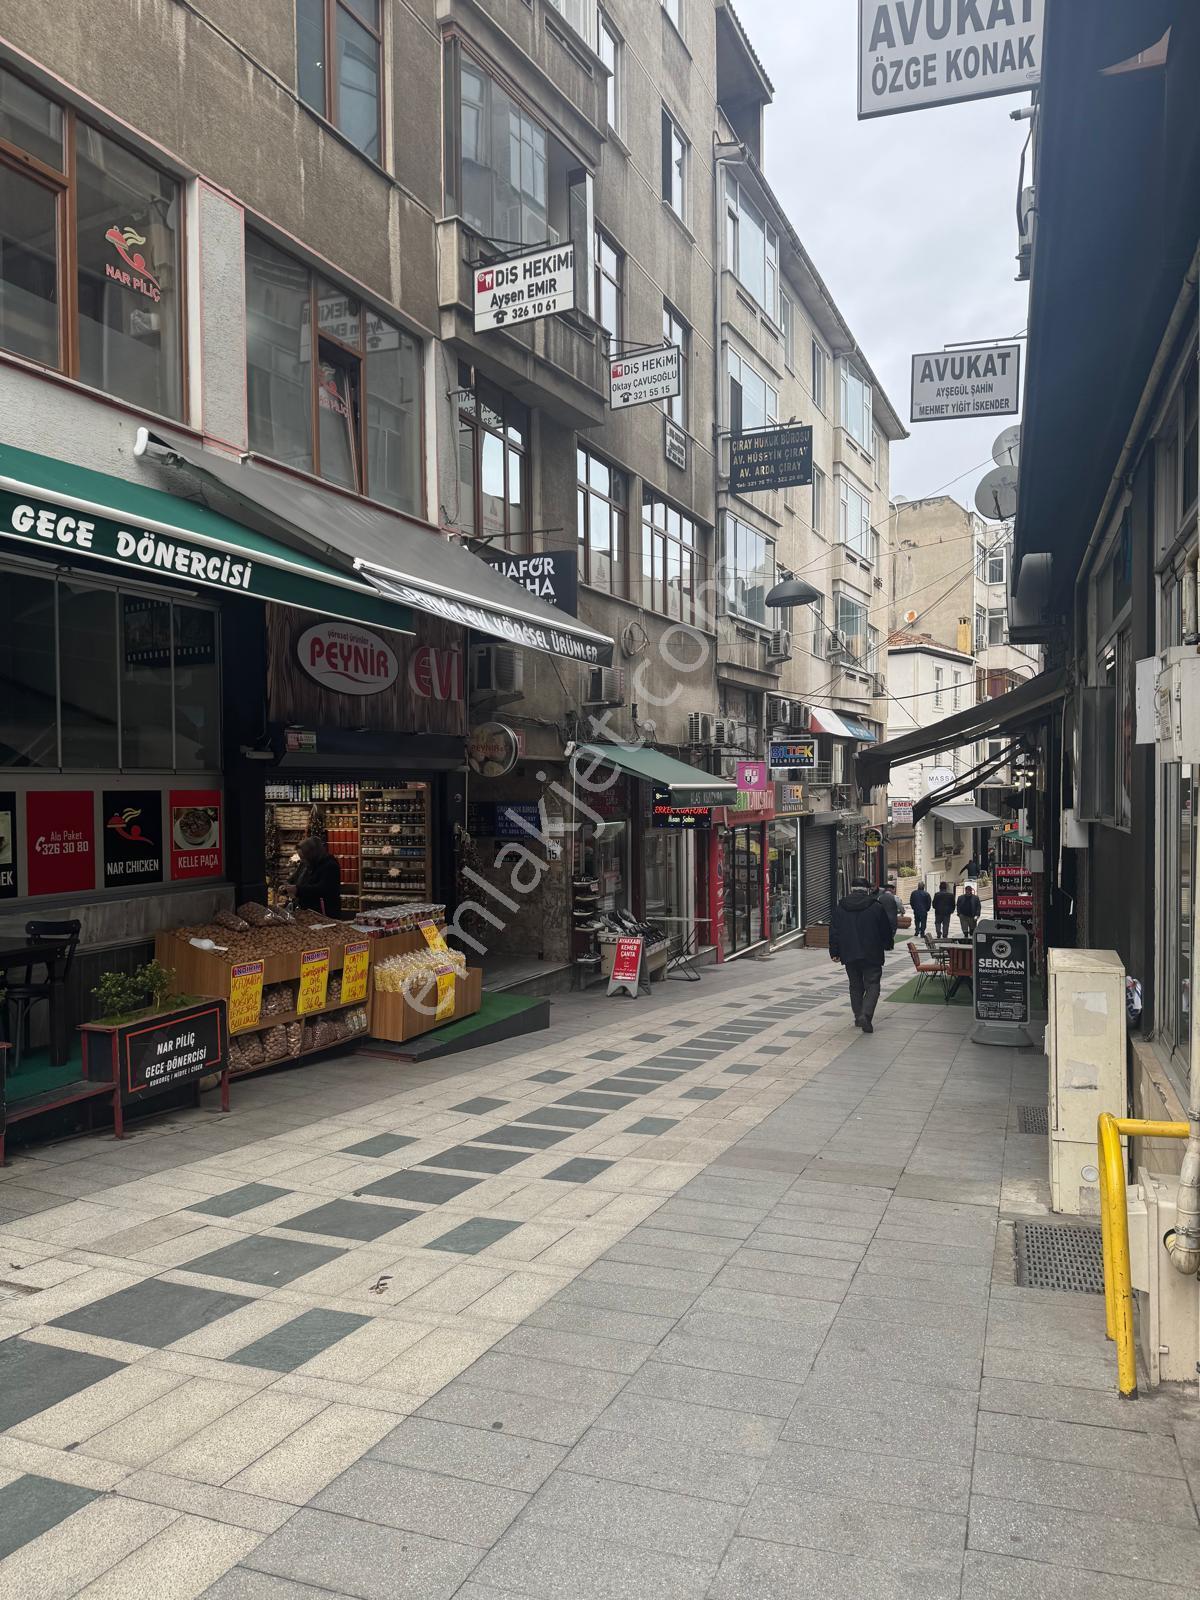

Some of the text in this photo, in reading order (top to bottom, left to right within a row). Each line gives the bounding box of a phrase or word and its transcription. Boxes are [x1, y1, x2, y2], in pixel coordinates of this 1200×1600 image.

[872, 35, 1036, 96] ÖZGE KONAK
[105, 263, 160, 302] NAR PİLİÇ
[490, 289, 524, 310] Ayşen
[512, 299, 557, 319] 326 10 61
[919, 352, 1011, 384] AVUKAT
[612, 370, 677, 393] Oktay ÇAVUŞOĞLU
[935, 381, 994, 399] AYŞEGÜL ŞAHİN
[633, 384, 670, 400] 321 55 15
[919, 398, 1010, 416] MEHMET YİĞİT İSKENDER
[754, 434, 779, 449] HUKUK
[747, 448, 782, 463] HÜSEYİN
[739, 461, 801, 478] AV. ARDA ÇIRAY
[11, 504, 252, 589] GECE DÖNERCİSİ
[550, 630, 598, 662] ÜRÜNLER
[310, 637, 389, 678] PEYNİR
[771, 745, 813, 759] BİLTEK
[62, 830, 82, 841] Paket
[42, 840, 89, 856] 326 30 80
[106, 858, 159, 876] NAR CHICKEN
[178, 853, 219, 869] KELLE PAÇA
[978, 958, 1026, 970] SERKAN
[156, 1032, 195, 1055] NAR PİLİÇ
[145, 1046, 207, 1079] GECE DÖNERCİSİ
